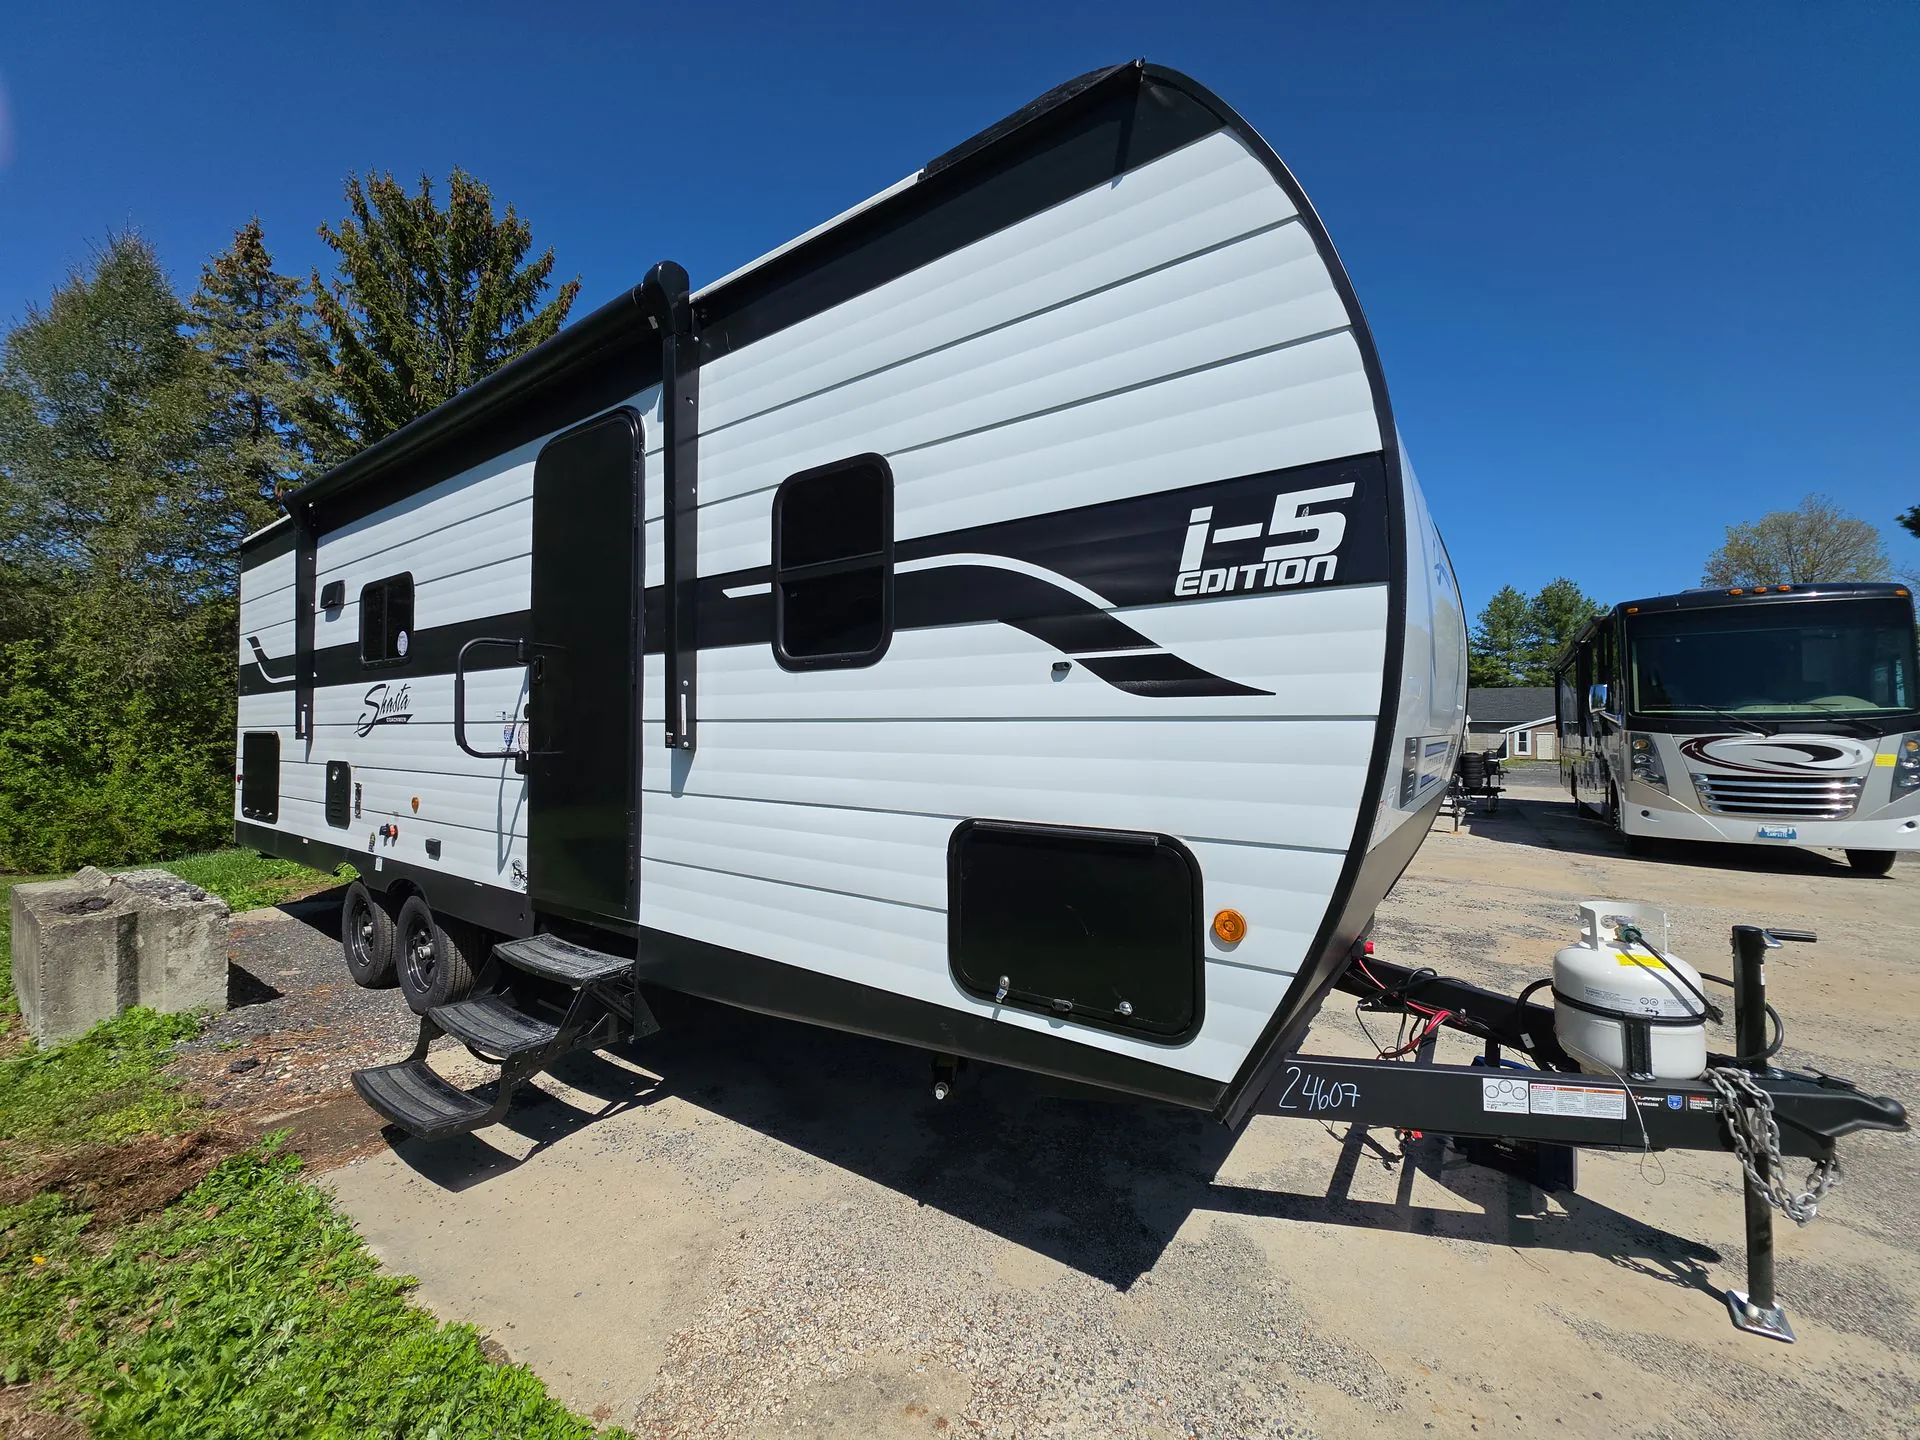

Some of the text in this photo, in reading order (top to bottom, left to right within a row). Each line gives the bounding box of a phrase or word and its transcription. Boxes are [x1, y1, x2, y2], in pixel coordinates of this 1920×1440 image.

[1178, 481, 1356, 572] i-5
[1174, 554, 1338, 597] EDITION
[354, 683, 412, 738] Shasta
[1279, 1066, 1361, 1111] 24607
